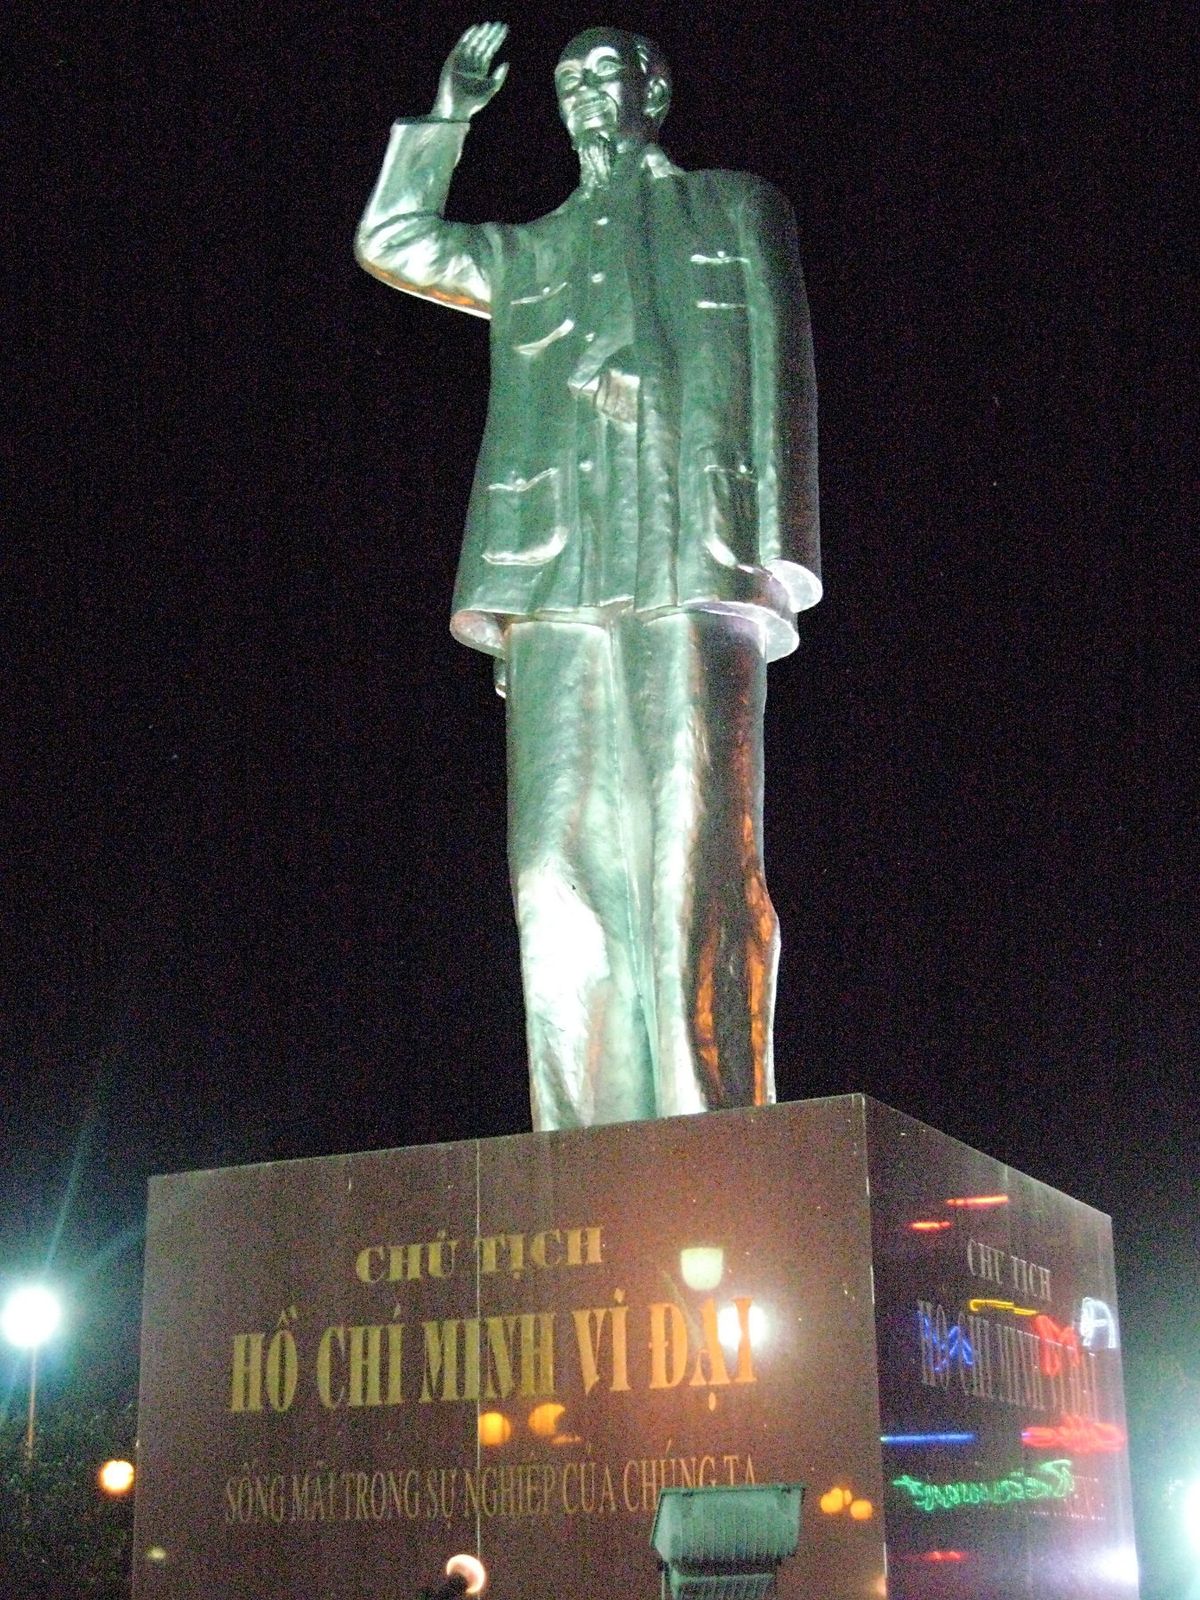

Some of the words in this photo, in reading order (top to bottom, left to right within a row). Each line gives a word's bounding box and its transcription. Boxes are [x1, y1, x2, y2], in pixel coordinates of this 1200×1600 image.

[474, 1226, 602, 1280] TỊCH
[317, 1304, 404, 1410] CHÍ
[419, 1312, 556, 1404] MINH
[649, 1296, 757, 1412] ĐẠI
[341, 1469, 419, 1521] TRONG
